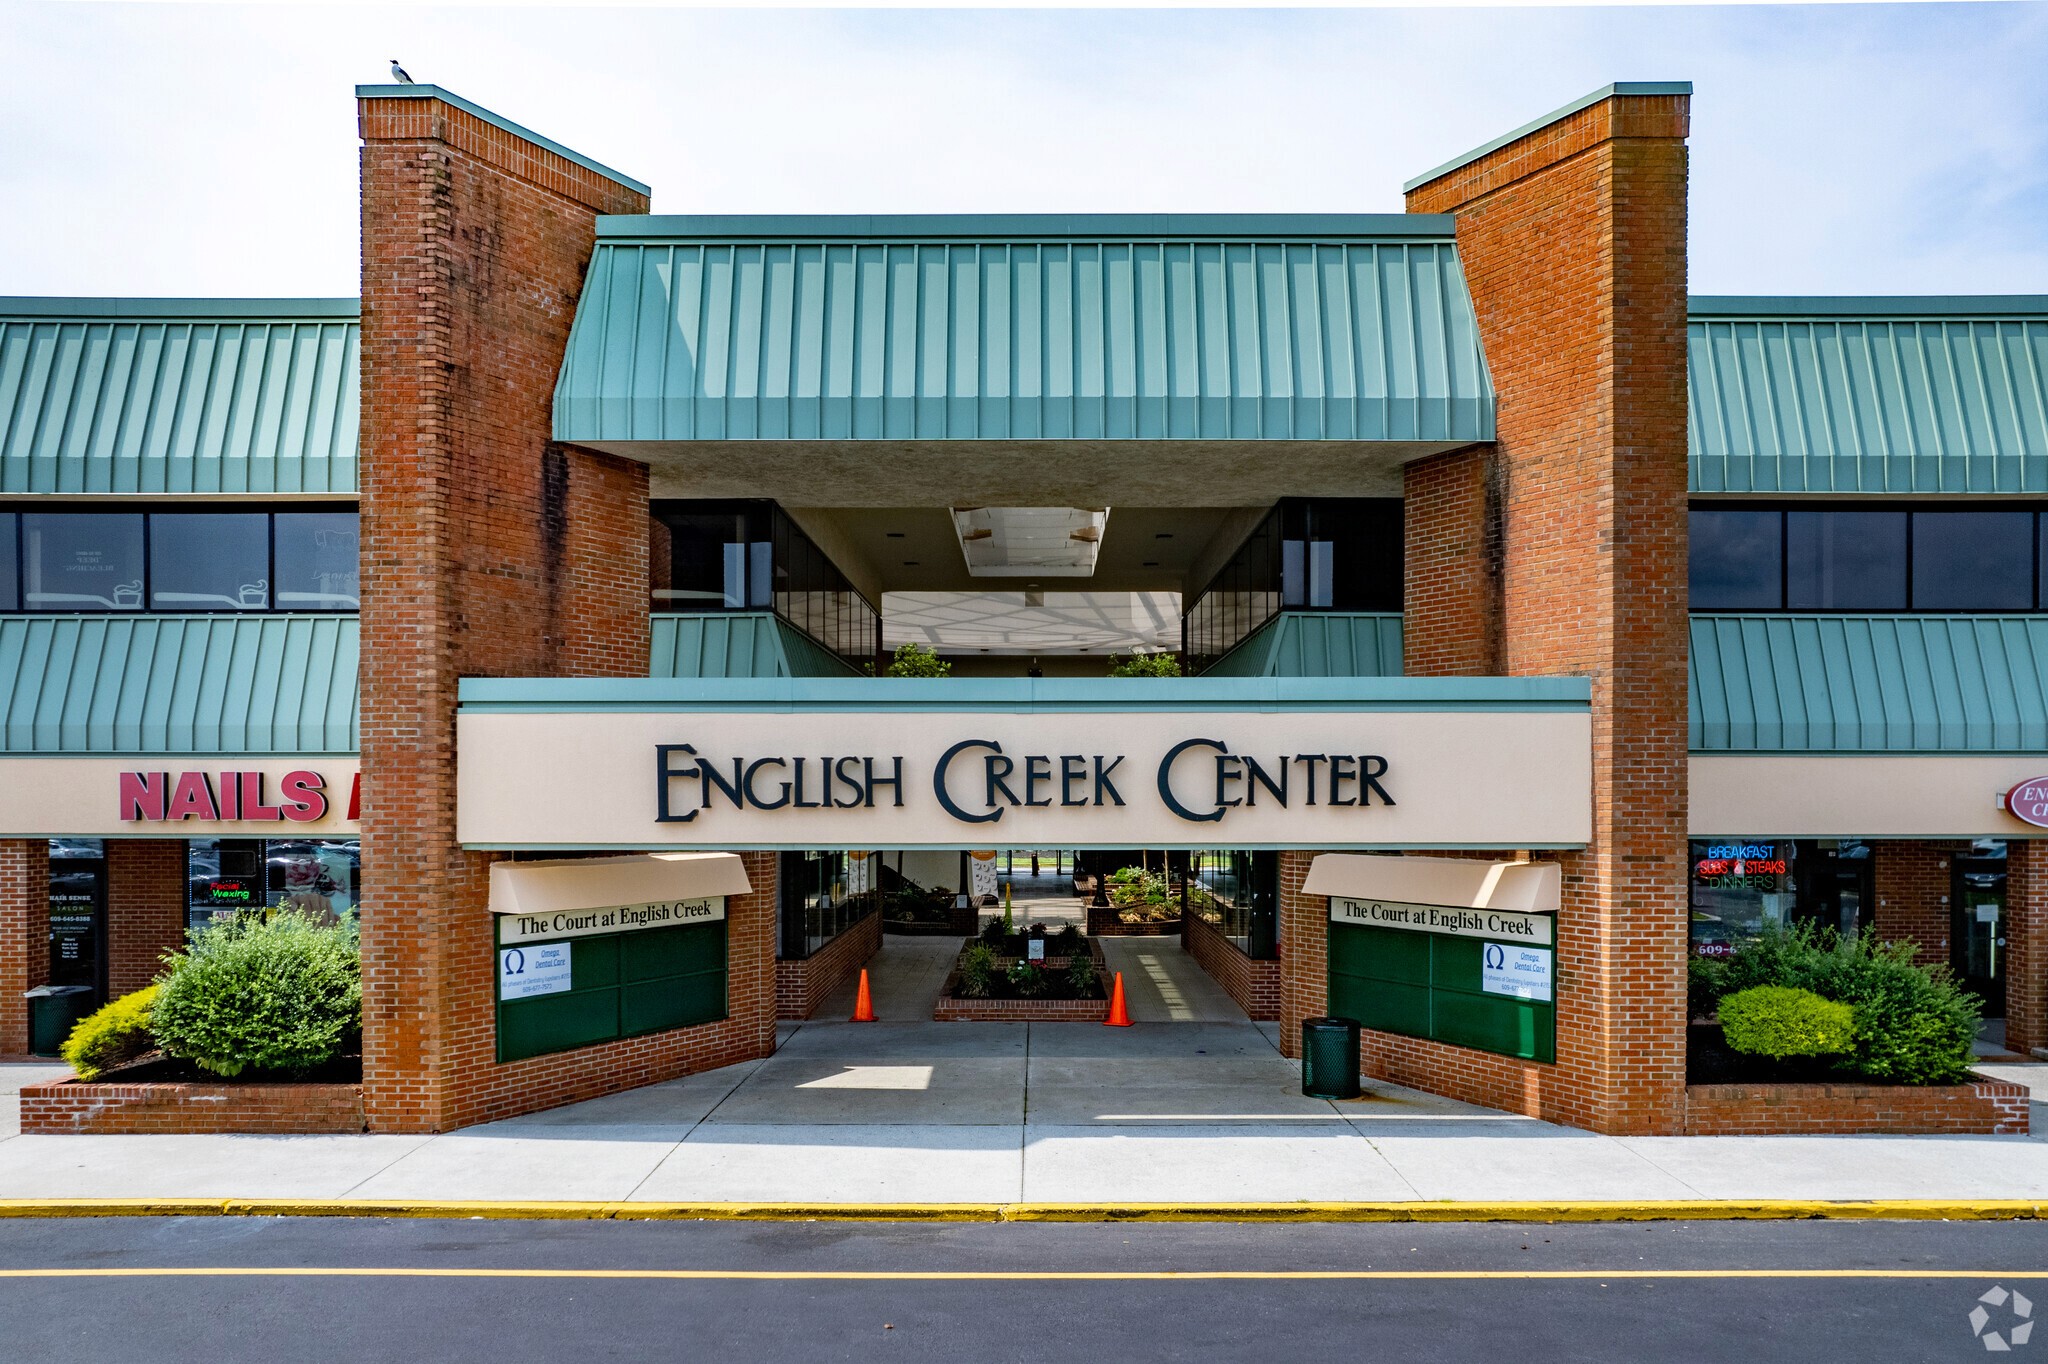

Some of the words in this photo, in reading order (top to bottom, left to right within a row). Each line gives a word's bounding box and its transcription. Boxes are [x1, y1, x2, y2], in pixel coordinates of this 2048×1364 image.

[655, 743, 904, 822] ENGLISH
[933, 739, 1126, 823] CREEK
[1157, 738, 1396, 822] CENTER
[120, 770, 329, 823] NAILS
[2023, 787, 2048, 801] EN
[1708, 846, 1775, 859] BREAKFAST
[1700, 861, 1728, 874] SUBS
[1746, 861, 1786, 874] STEAKS
[210, 882, 239, 891] Facial
[1709, 876, 1774, 889] DINNERS
[212, 889, 250, 900] Waxing
[518, 917, 548, 935] The
[553, 914, 597, 932] Court
[602, 911, 615, 927] at
[620, 905, 670, 926] English
[674, 901, 711, 919] Creek
[1344, 901, 1368, 919] The
[1371, 904, 1409, 923] Court
[1413, 910, 1426, 924] at
[1429, 909, 1483, 932] English
[1488, 914, 1534, 935] Creek
[541, 950, 560, 958] Omega
[1699, 945, 1737, 954] 609-6
[1521, 952, 1540, 962] Omega
[536, 960, 553, 969] Dental
[554, 959, 566, 967] Care
[1514, 962, 1532, 972] Dental
[1532, 964, 1545, 973] Care
